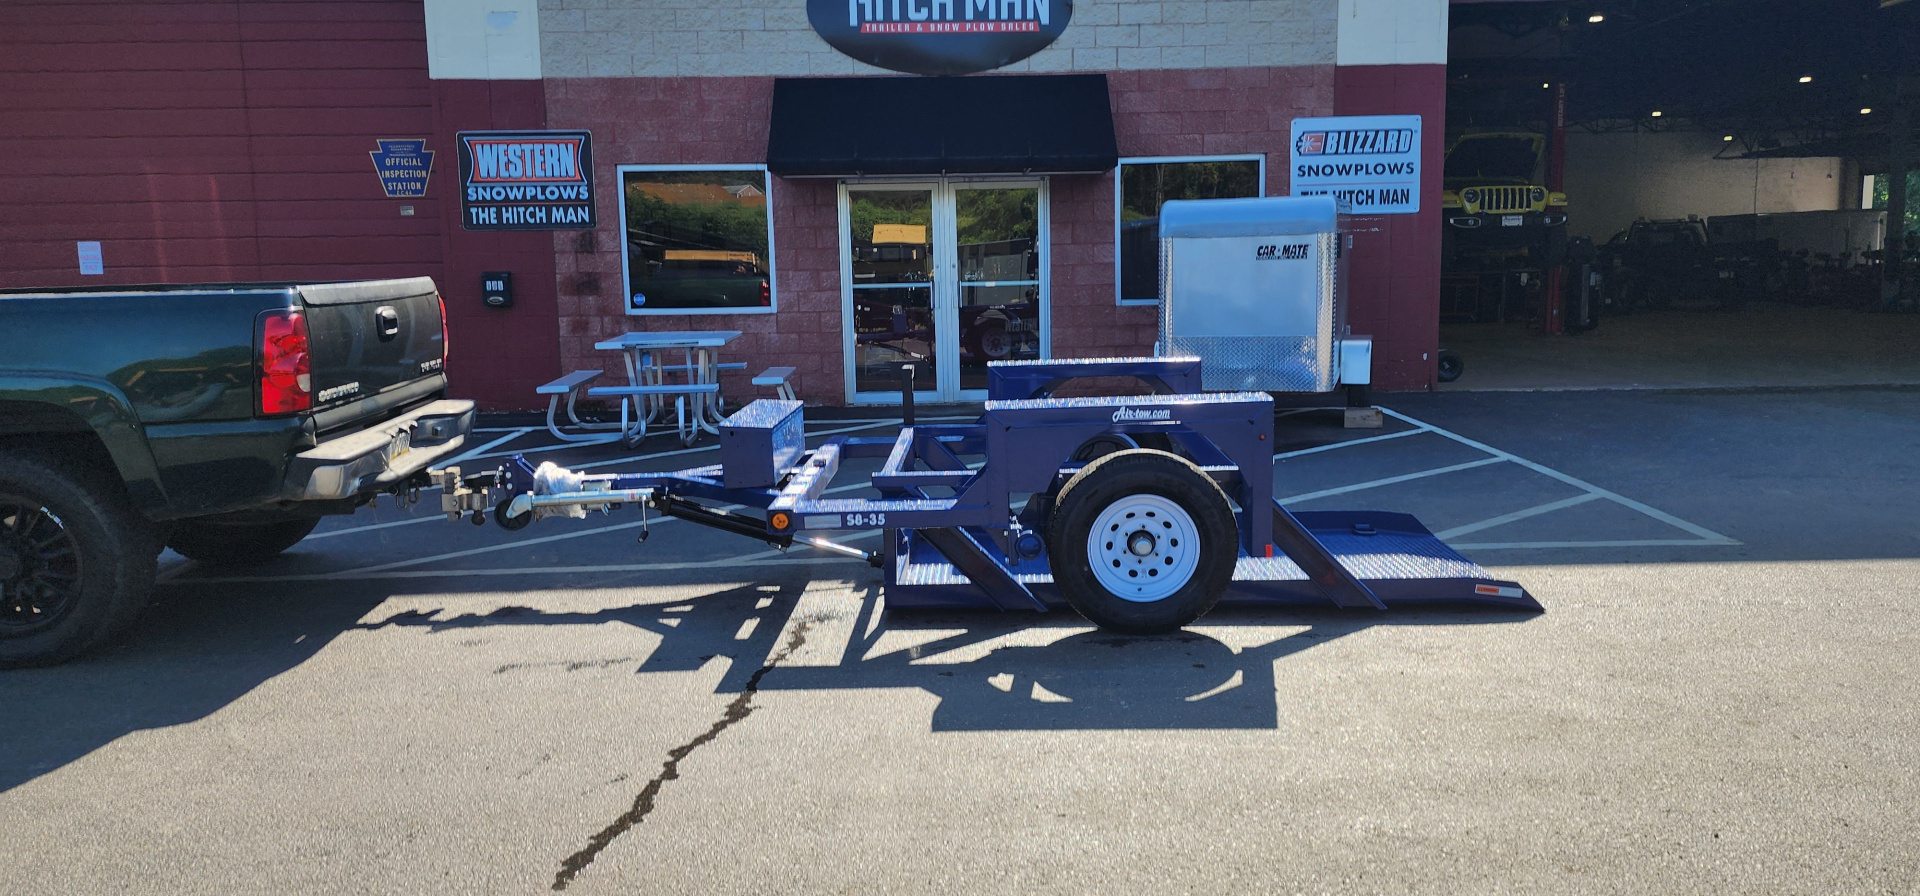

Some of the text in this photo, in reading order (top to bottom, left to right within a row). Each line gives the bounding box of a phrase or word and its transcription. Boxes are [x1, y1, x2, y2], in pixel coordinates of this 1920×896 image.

[865, 23, 910, 32] TRAILER
[930, 23, 959, 32] SNOW
[966, 22, 995, 31] PLOW
[1001, 22, 1035, 31] SALES
[1325, 130, 1413, 154] BLIZZARD
[385, 158, 422, 166] OFFICIAL
[475, 143, 575, 179] WESTERN
[381, 170, 427, 178] INSPECTION
[1297, 162, 1414, 178] SNOWPLOWS
[388, 181, 421, 190] STATION
[467, 185, 589, 201] SNOWPLOWS
[1379, 188, 1410, 205] MAN
[469, 206, 589, 225] THE HITCH MAN
[1005, 318, 1038, 332] WESTERN
[1112, 406, 1171, 423] Air-tow.com
[846, 513, 886, 527] S8-35
